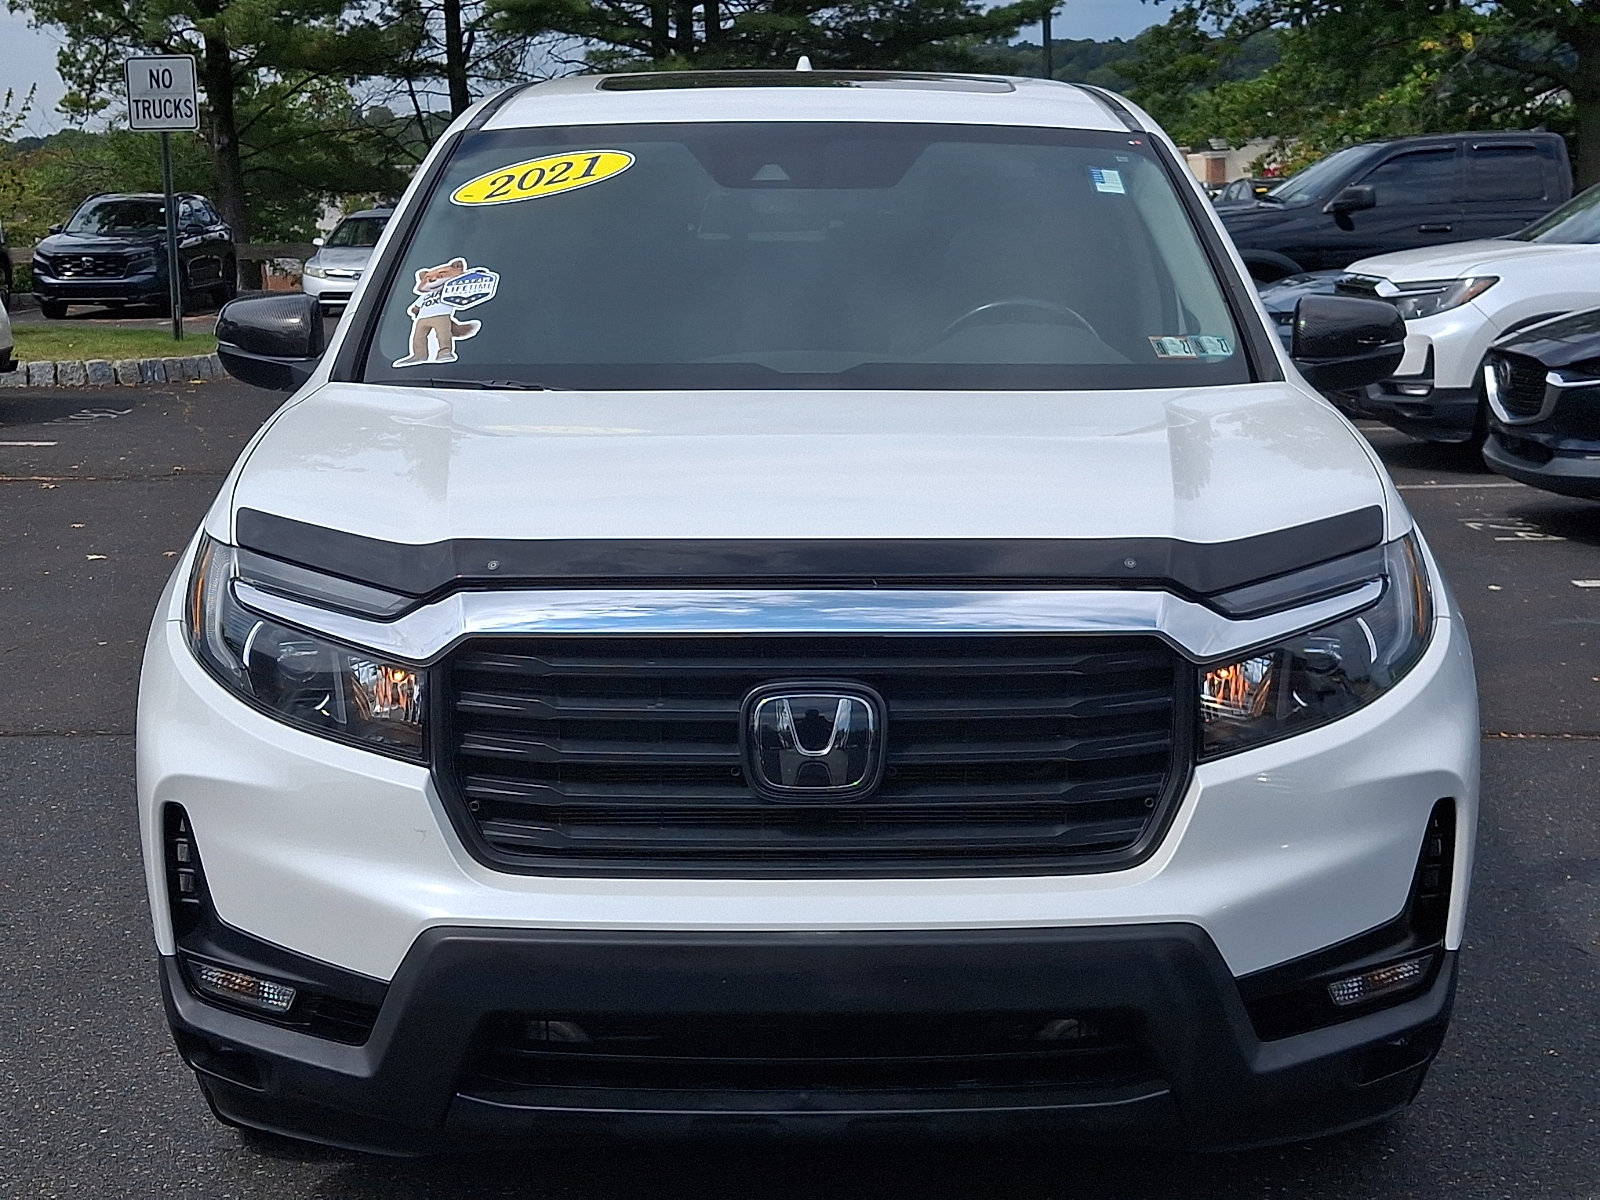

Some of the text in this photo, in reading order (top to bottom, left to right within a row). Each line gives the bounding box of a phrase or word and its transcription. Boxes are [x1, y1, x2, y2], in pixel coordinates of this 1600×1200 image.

[148, 67, 173, 89] NO
[132, 98, 194, 120] TRUCKS
[483, 155, 602, 200] 2021
